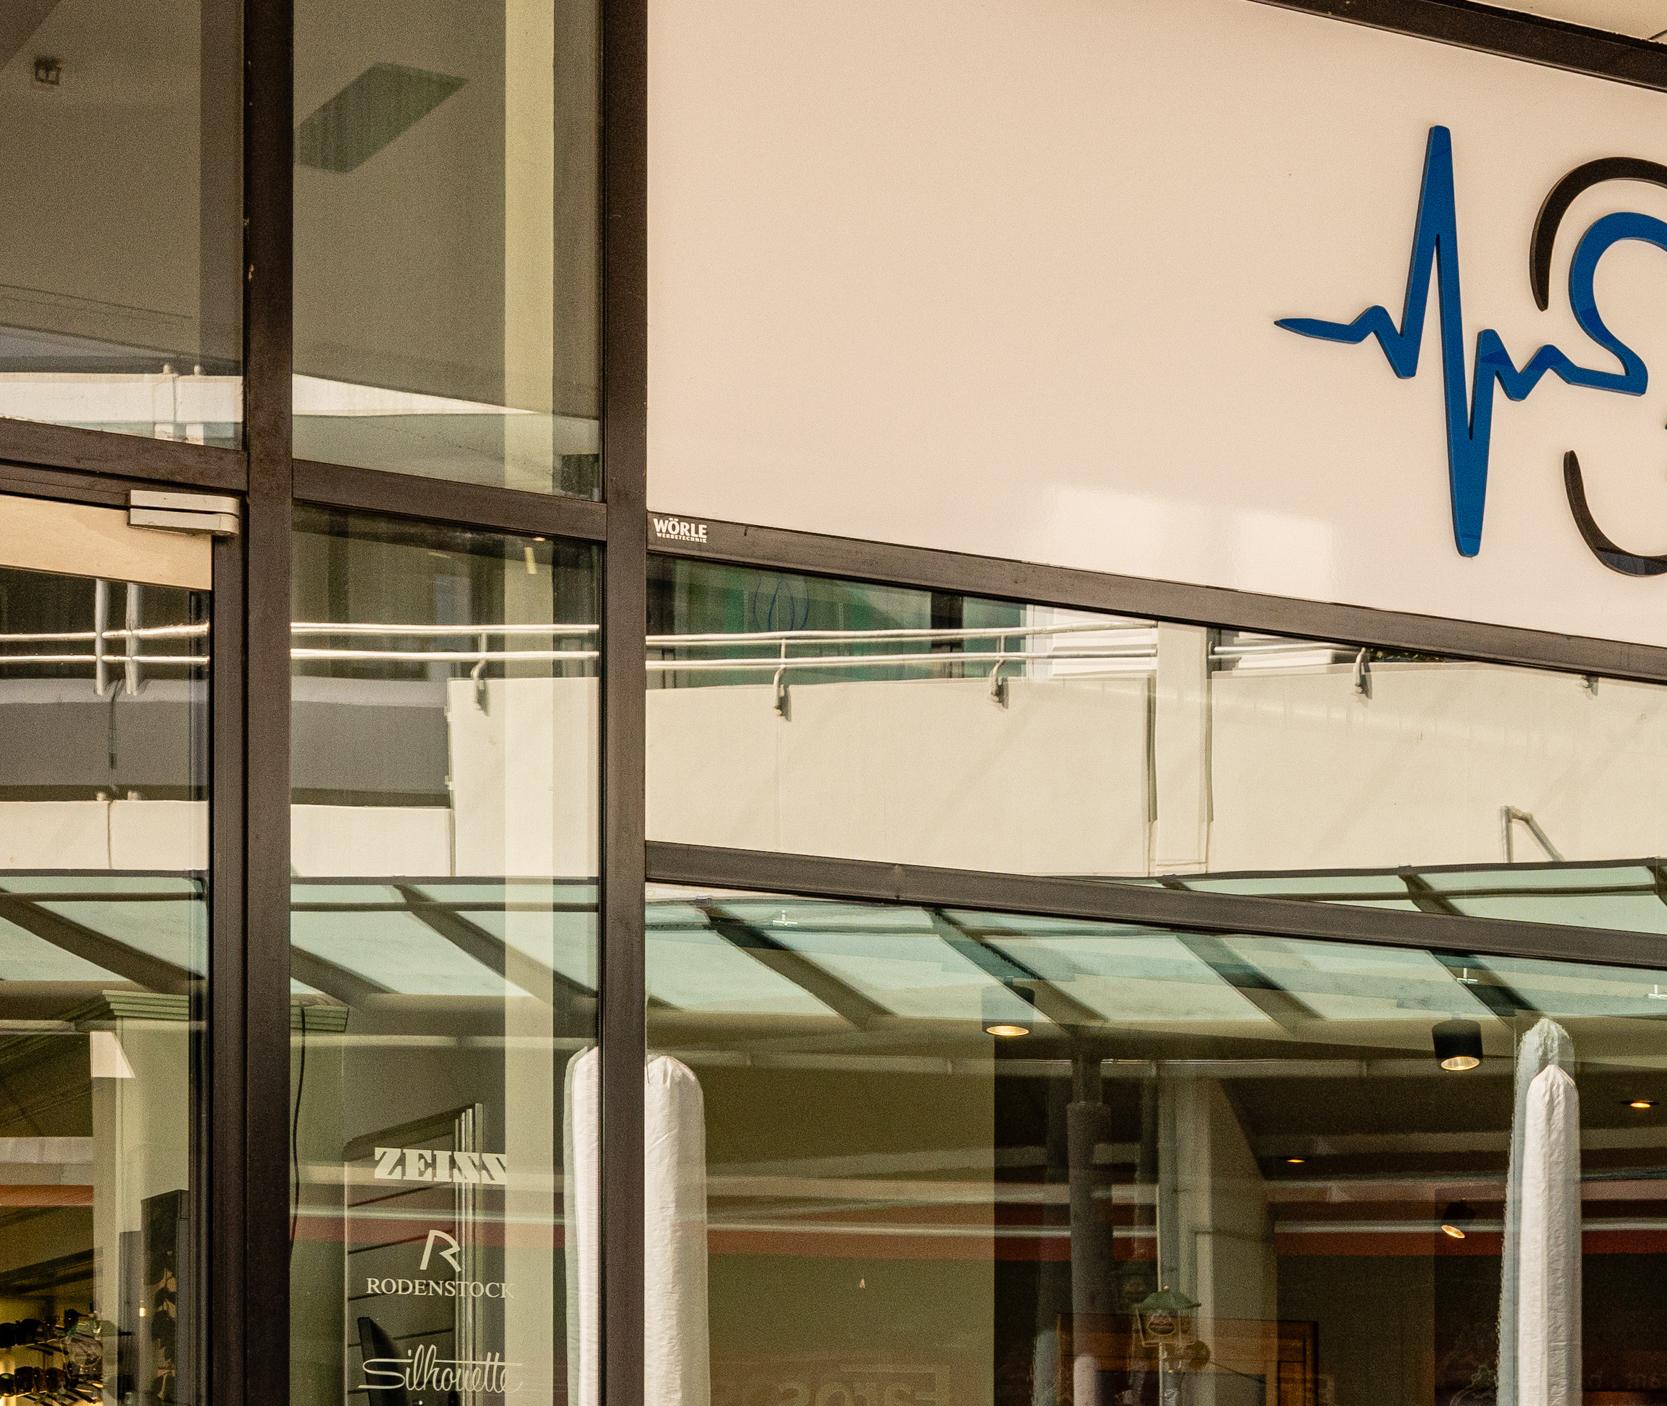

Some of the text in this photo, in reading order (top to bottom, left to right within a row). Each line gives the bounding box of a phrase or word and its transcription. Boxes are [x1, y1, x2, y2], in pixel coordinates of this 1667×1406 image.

[653, 517, 707, 539] WÖRLE
[374, 1147, 508, 1185] ZEISS
[365, 1277, 514, 1299] RODENSTOCK
[358, 1344, 523, 1393] Silhouette
